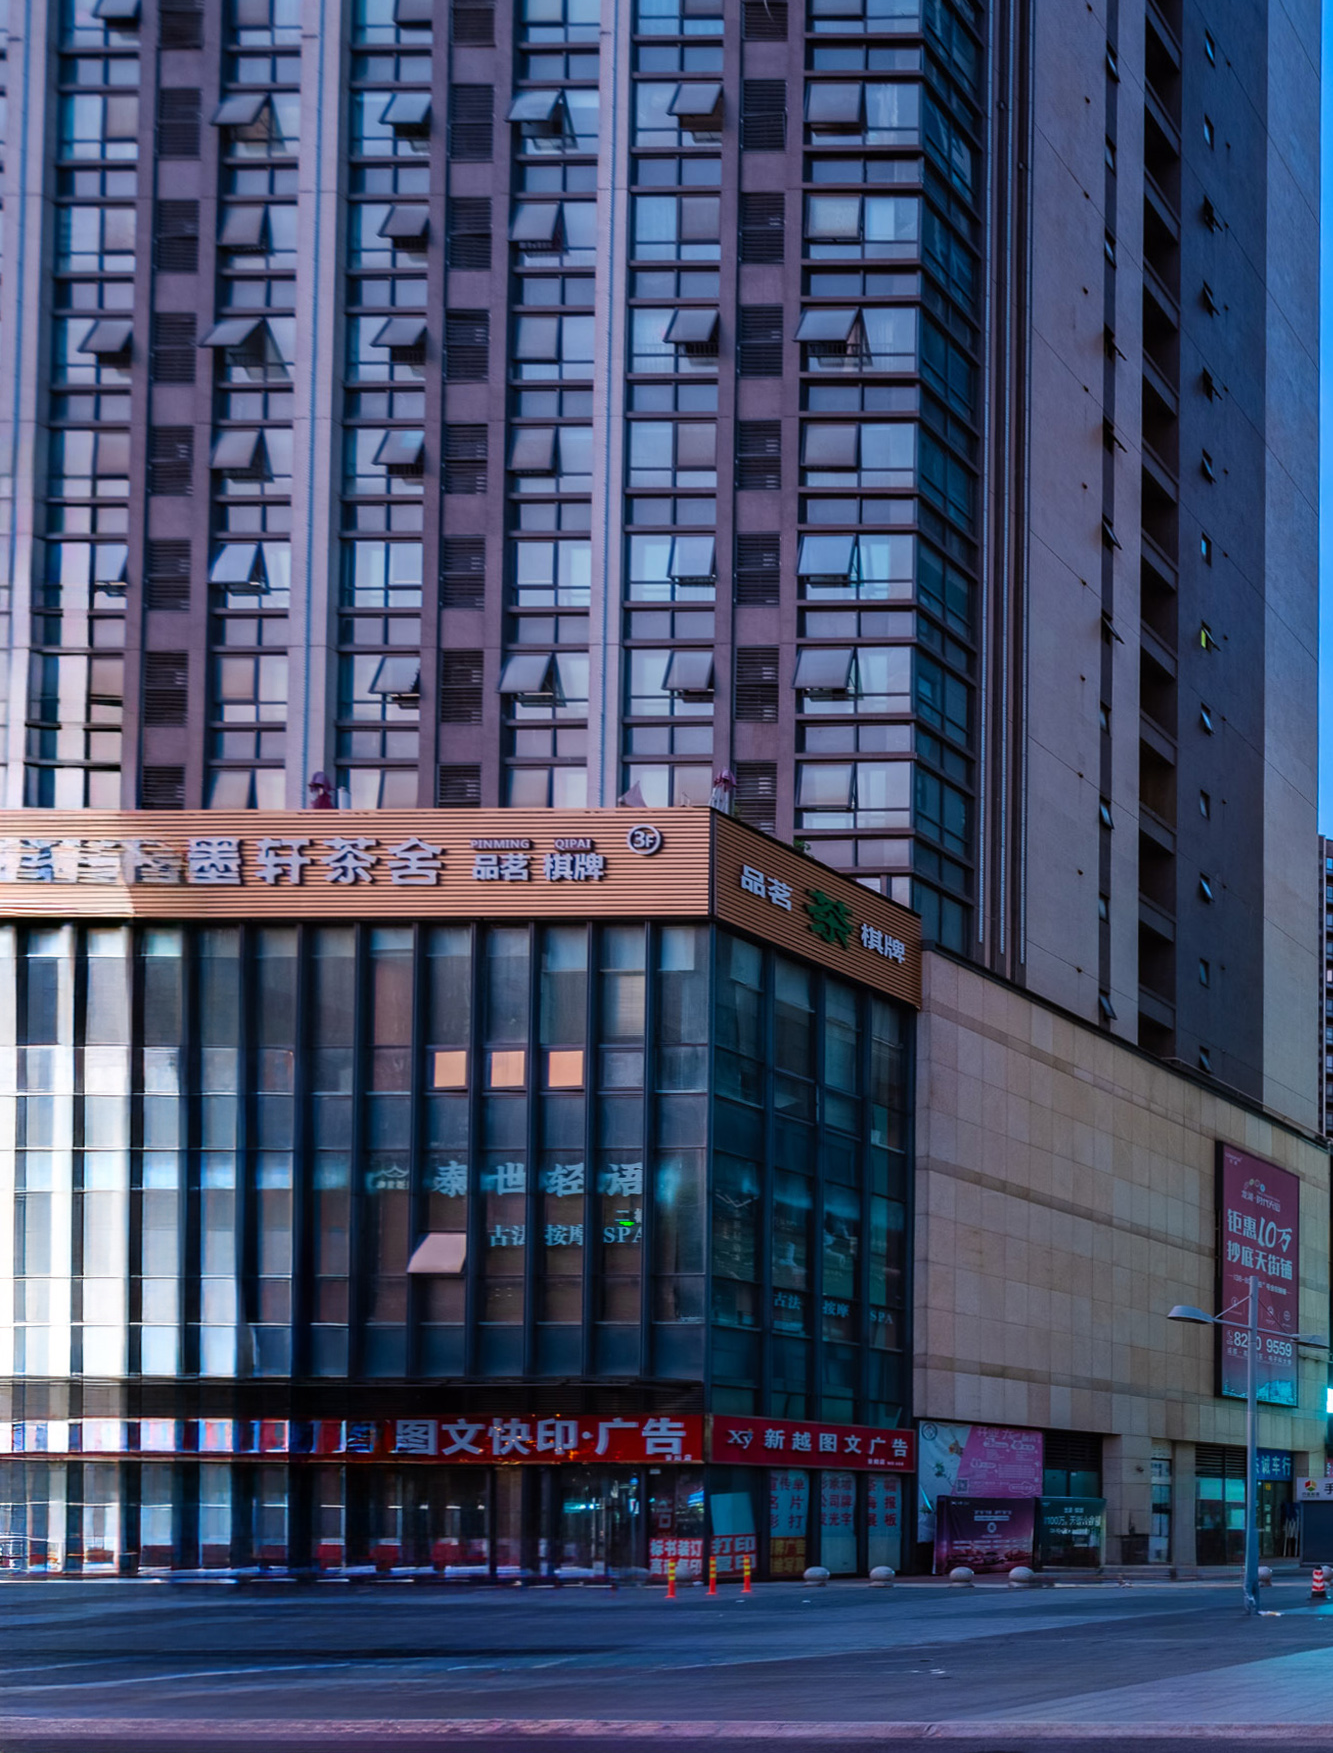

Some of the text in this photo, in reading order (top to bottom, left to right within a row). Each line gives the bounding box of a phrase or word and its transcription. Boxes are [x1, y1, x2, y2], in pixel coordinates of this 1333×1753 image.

[470, 839, 592, 851] PINMING QIPAI
[472, 853, 605, 882] 品茗 棋牌
[740, 864, 794, 912] 品茗
[860, 922, 906, 965] 棋牌
[1233, 1331, 1292, 1357] 820 9559
[764, 1428, 908, 1458] 新越图文广告
[712, 1536, 756, 1555] 打印
